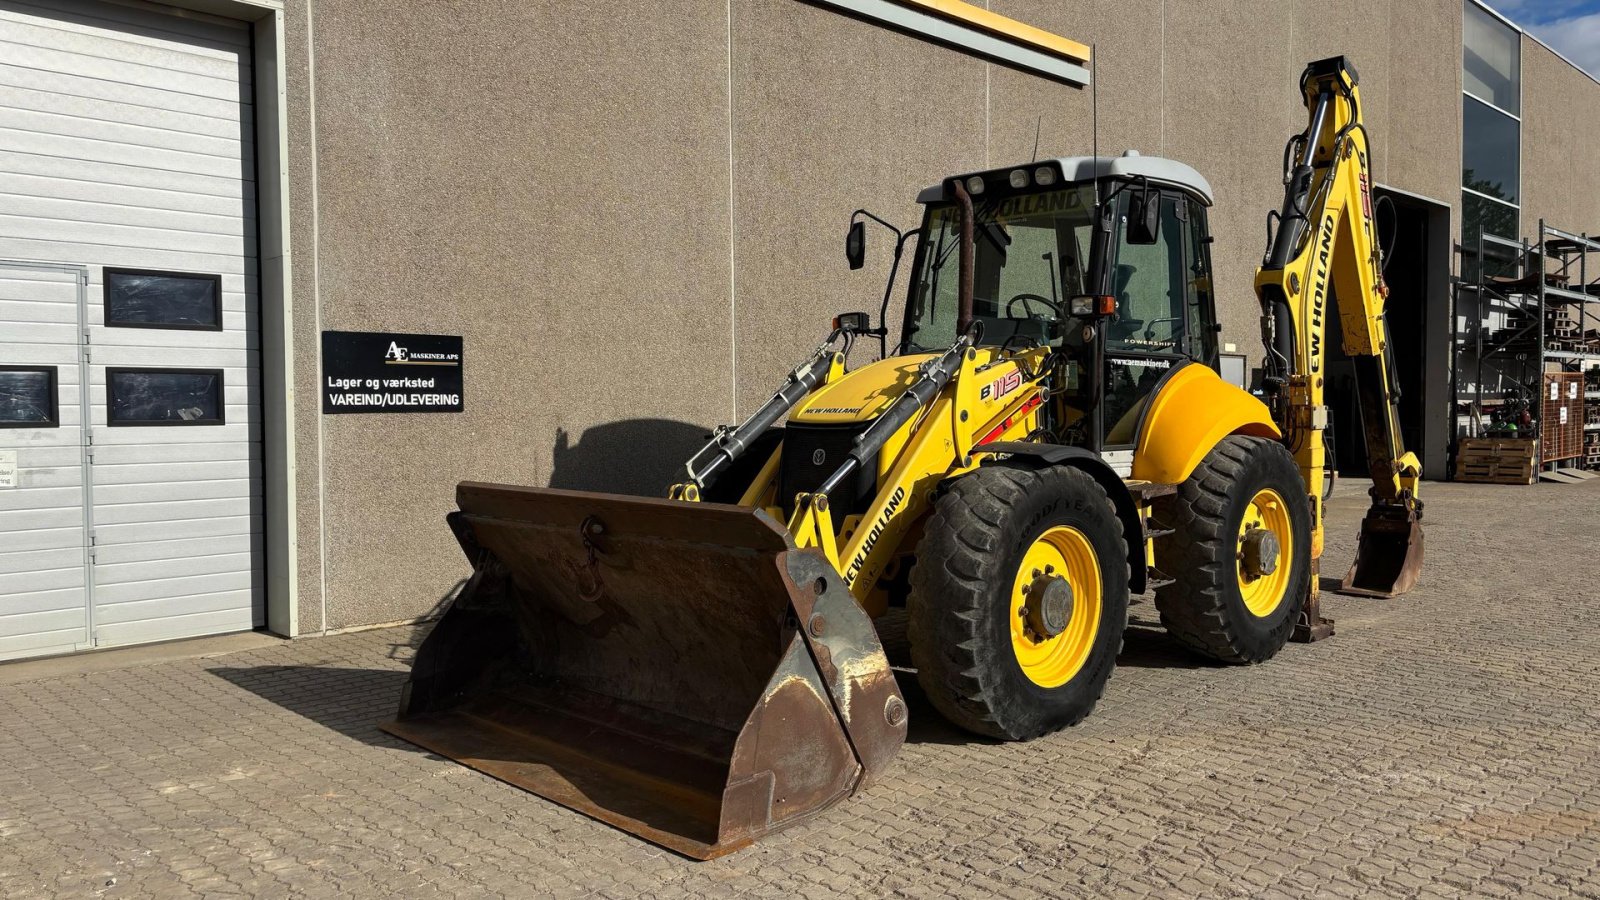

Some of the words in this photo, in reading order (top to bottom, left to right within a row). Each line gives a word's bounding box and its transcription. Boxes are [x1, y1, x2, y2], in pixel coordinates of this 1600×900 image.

[1001, 190, 1082, 218] OLLAND
[1312, 215, 1334, 328] HOLLAND
[1124, 338, 1177, 347] POWERSHIFT
[410, 352, 445, 360] MASKINER
[1311, 337, 1321, 373] EW
[328, 376, 362, 390] Lager
[365, 380, 379, 390] og
[383, 376, 434, 388] værksted
[329, 392, 460, 407] VAREIND/UDLEVERING
[861, 486, 905, 556] HOLLAND
